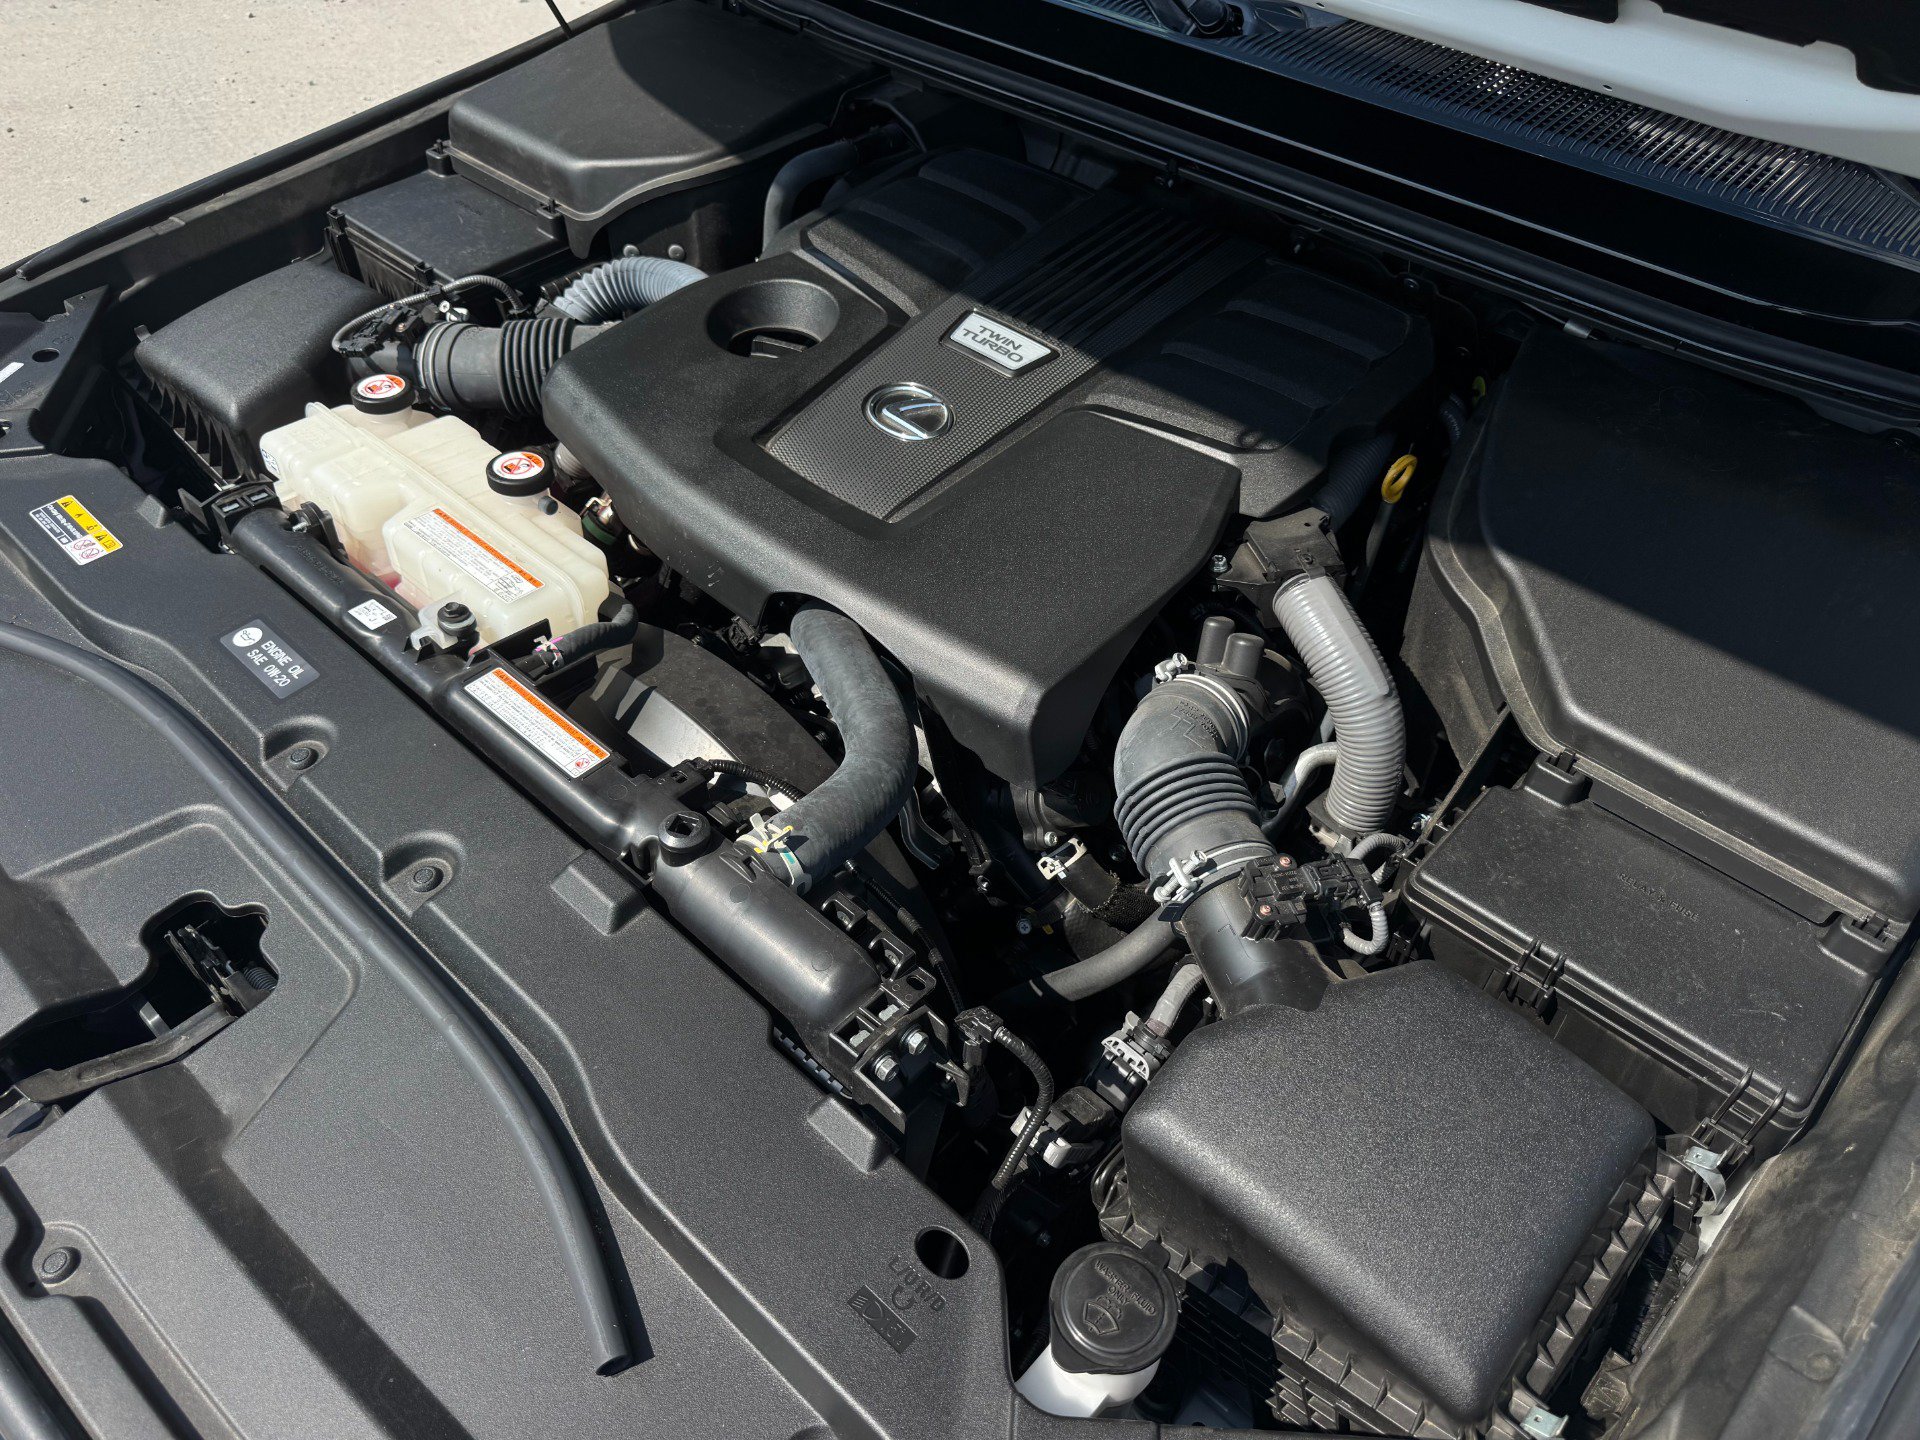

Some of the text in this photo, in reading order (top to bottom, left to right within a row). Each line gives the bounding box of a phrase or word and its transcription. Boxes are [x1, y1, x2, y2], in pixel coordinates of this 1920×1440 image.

[962, 328, 1024, 363] TURBO
[979, 325, 1023, 351] TWIN
[246, 649, 269, 666] SAE
[261, 640, 305, 680] ENGINE OIL
[1619, 873, 1656, 895] RELAY
[1669, 901, 1700, 922] FUSE
[1107, 1285, 1131, 1305] ONLY
[1130, 1291, 1157, 1316] FLUID
